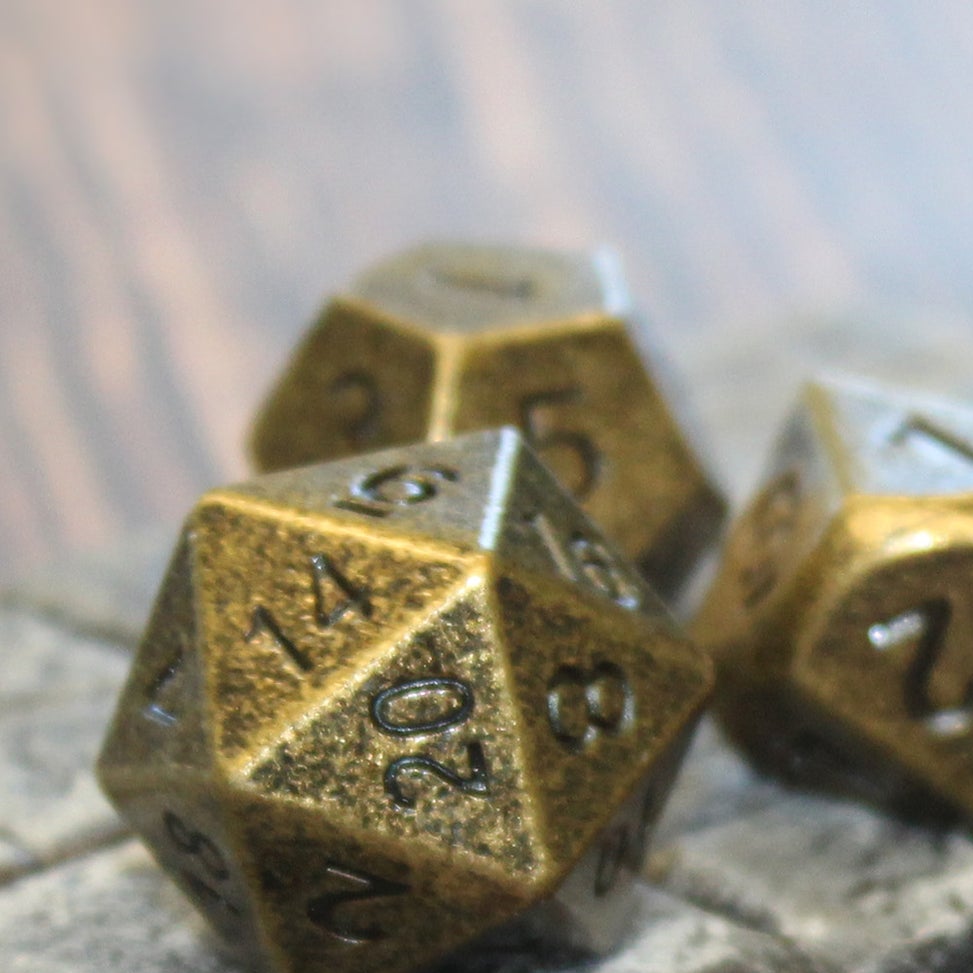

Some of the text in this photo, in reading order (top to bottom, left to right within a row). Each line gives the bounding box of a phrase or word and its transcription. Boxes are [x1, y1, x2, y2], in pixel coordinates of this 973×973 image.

[513, 380, 604, 504] 5
[244, 552, 372, 672] 14
[370, 676, 490, 812] 20
[546, 660, 636, 752] 8
